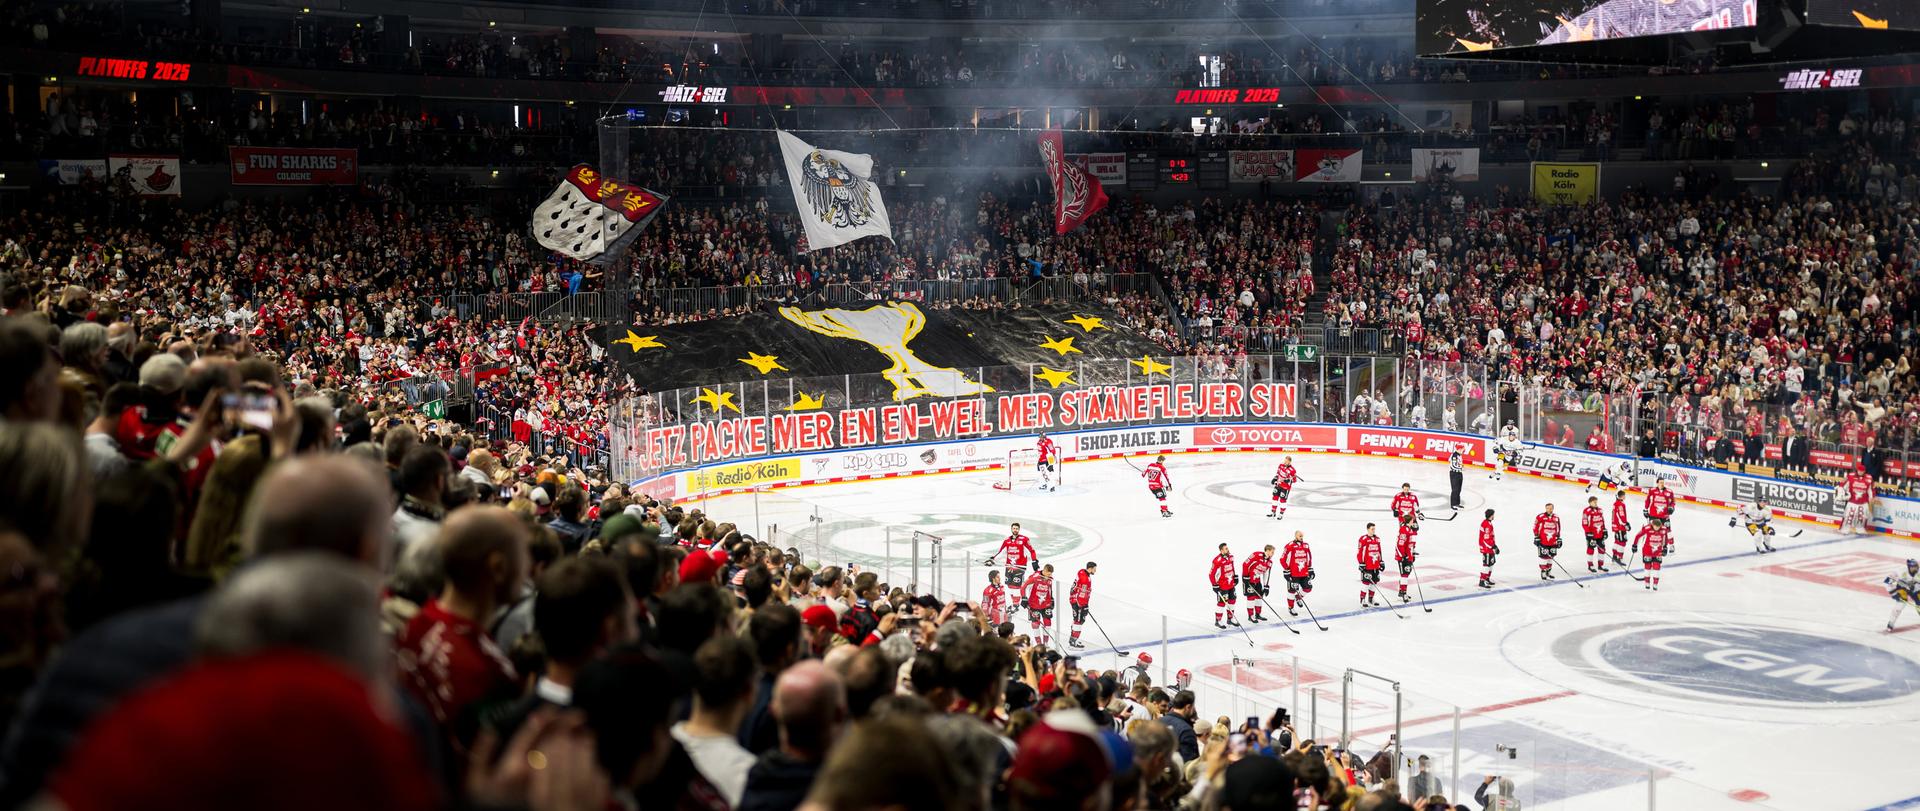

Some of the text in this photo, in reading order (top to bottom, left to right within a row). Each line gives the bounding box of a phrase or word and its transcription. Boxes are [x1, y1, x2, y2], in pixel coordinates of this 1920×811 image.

[78, 57, 191, 81] PLAYOFFS 2025
[1830, 69, 1863, 88] SIEL
[701, 87, 728, 103] SIEL
[1175, 88, 1281, 104] PLAYOFFS 2025
[249, 154, 337, 169] FUN SHARKS
[276, 172, 311, 181] COLOGNE
[1170, 173, 1189, 181] 4:23
[1551, 169, 1579, 178] Radio
[1553, 181, 1576, 189] Köln
[639, 424, 687, 471] JETZ
[690, 416, 768, 462] PACKE
[773, 411, 834, 453] MER
[841, 407, 877, 446] EN
[998, 393, 1054, 432] MER
[1059, 383, 1243, 426] STÄÄNEFLEJER
[1250, 383, 1298, 418] SIN
[1080, 430, 1180, 451] SHOP.HAIE.DE
[1240, 429, 1303, 442] TOYOTA
[873, 453, 908, 469] CLUB
[716, 466, 752, 485] Radio
[757, 463, 788, 479] Köln
[1759, 482, 1829, 504] TRICORP
[1769, 498, 1818, 513] WORKWEAR
[1648, 635, 1889, 694] CGM
